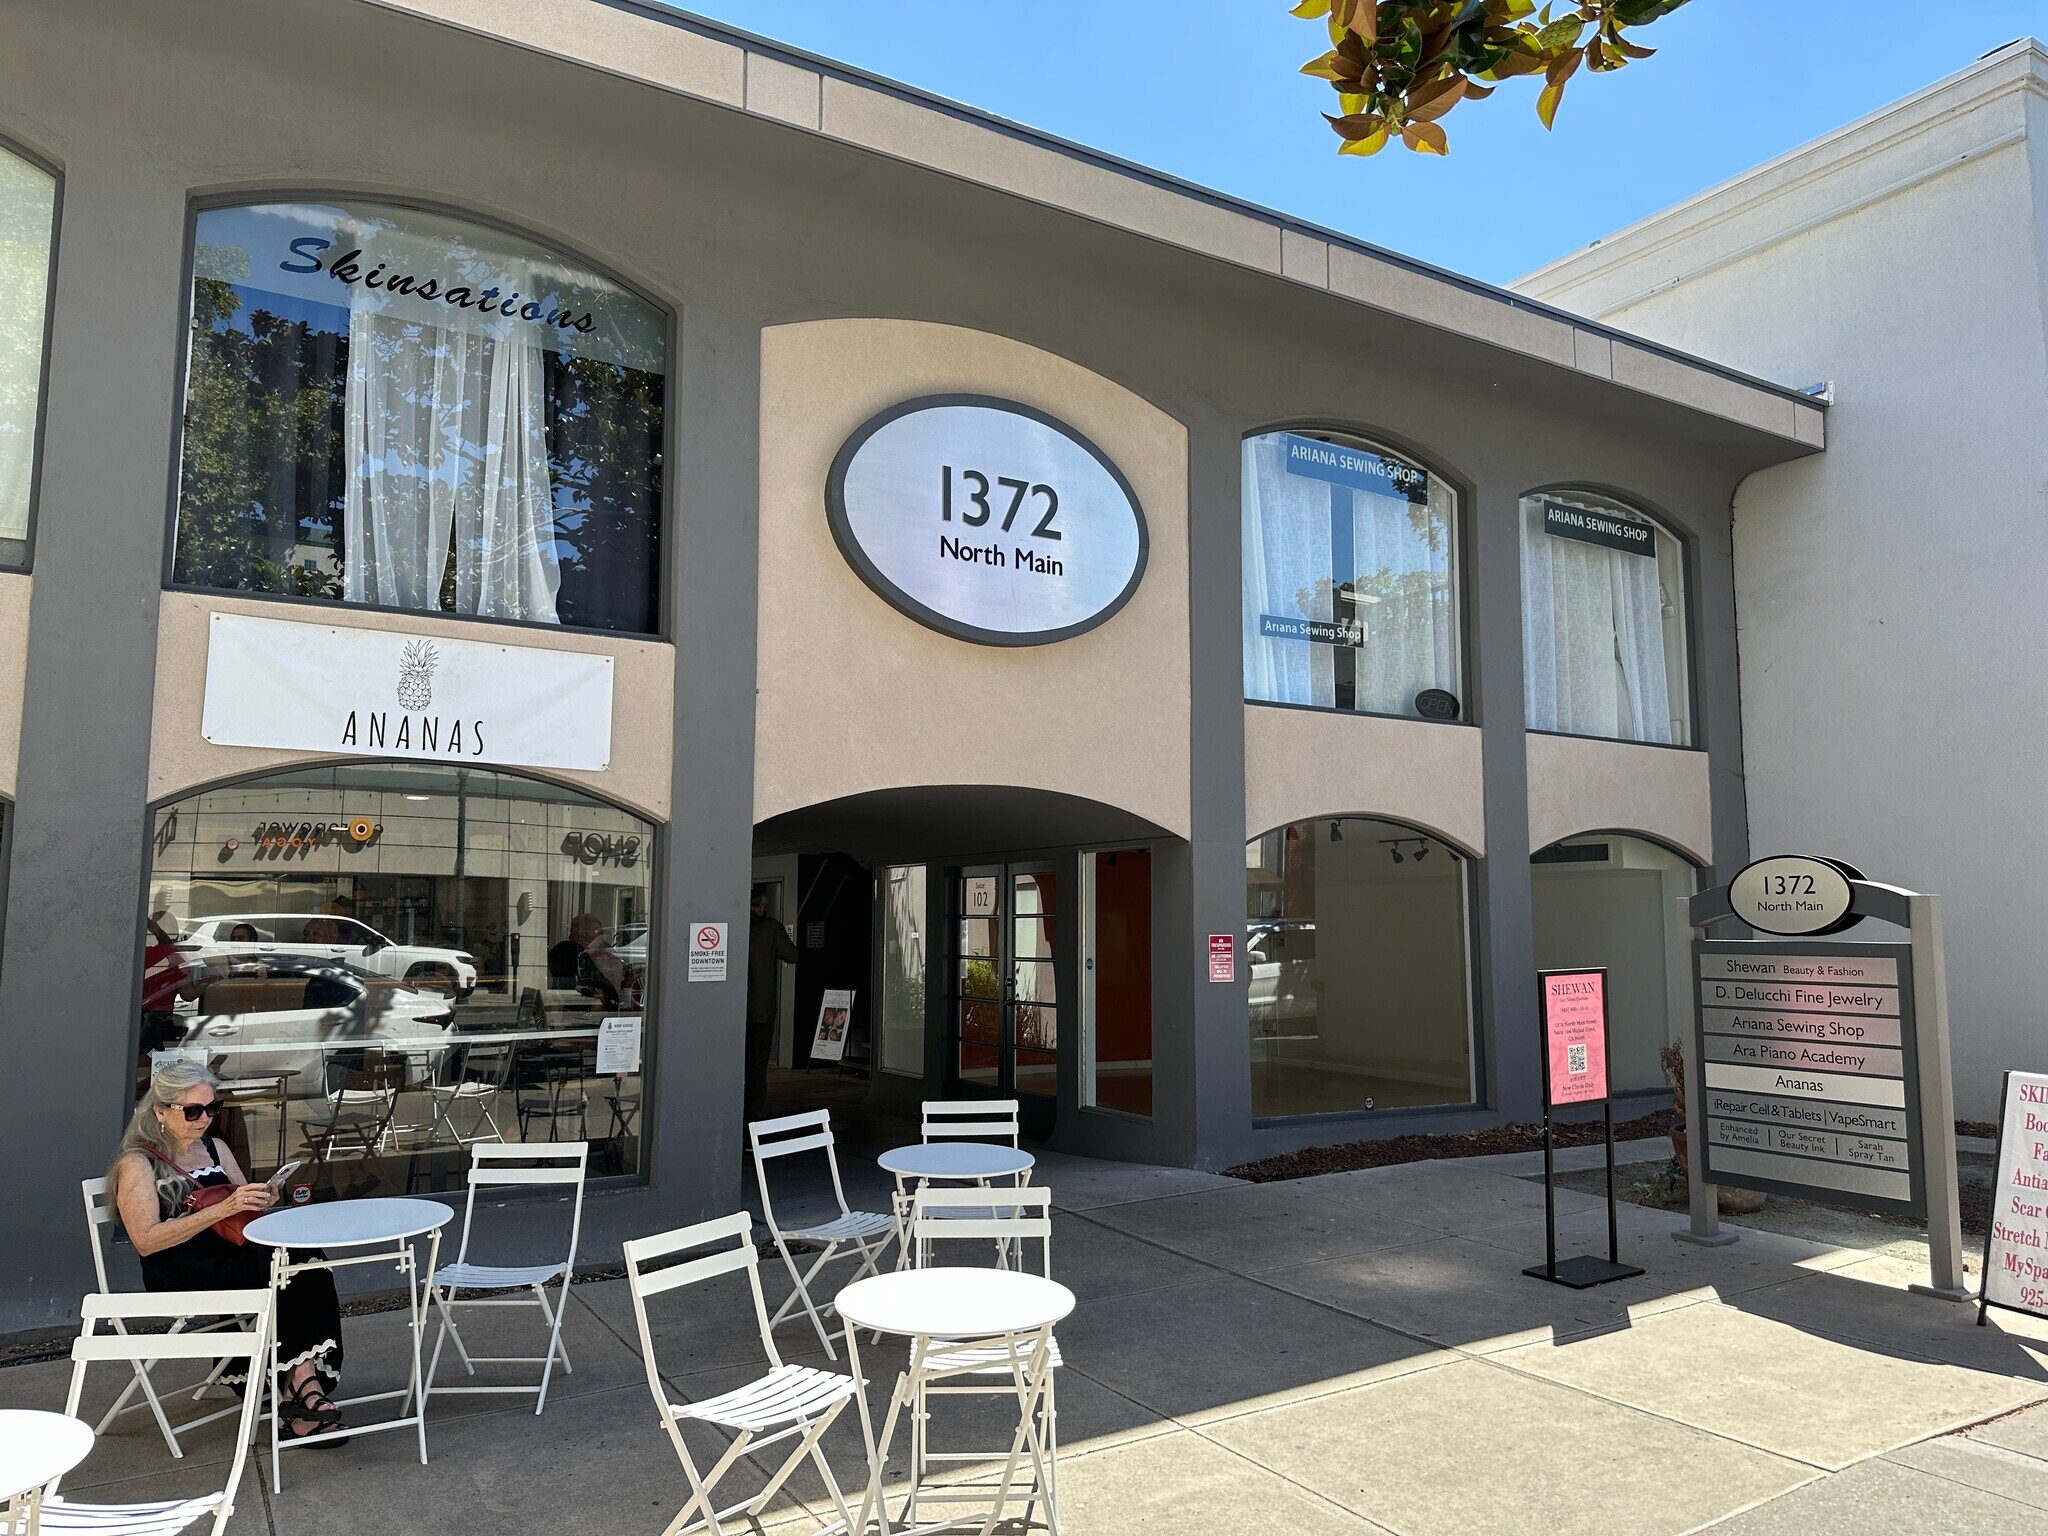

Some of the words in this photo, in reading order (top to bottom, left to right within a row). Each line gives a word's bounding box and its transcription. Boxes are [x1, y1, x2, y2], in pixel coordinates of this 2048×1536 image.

[280, 237, 597, 334] Skinsations
[1291, 445, 1337, 466] ARIANA
[1340, 455, 1385, 477] SEWING
[1387, 465, 1418, 482] SHOP
[942, 465, 1062, 540] 1372
[1548, 508, 1584, 528] ARIANA
[1586, 517, 1622, 537] SEWING
[1623, 527, 1648, 542] SHOP
[940, 535, 1005, 567] North
[1015, 547, 1063, 576] Main
[1265, 620, 1297, 634] Ariana
[1300, 623, 1335, 639] Sewing
[1337, 627, 1361, 642] Shop
[1420, 696, 1455, 714] OPEN
[342, 710, 484, 756] ANANAS
[1764, 875, 1816, 895] 1372
[973, 891, 988, 907] 102
[1757, 901, 1792, 911] North
[1796, 901, 1823, 911] Main
[1727, 960, 1776, 974] Shewan
[1783, 965, 1814, 977] Beauty
[1817, 966, 1825, 975] &
[1828, 966, 1864, 976] Fashion
[1551, 982, 1595, 996] SHEWAN
[1715, 986, 1730, 999] D.
[1735, 986, 1791, 1002] Delucchi
[1795, 990, 1824, 1003] Fine
[1828, 991, 1883, 1010] Jewelry
[1732, 1016, 1773, 1030] Ariana
[1777, 1018, 1825, 1038] Sewing
[1829, 1022, 1865, 1040] Shop
[1733, 1044, 1756, 1057] Ara
[1760, 1045, 1796, 1060] Piano
[1800, 1049, 1866, 1069] Academy
[1775, 1075, 1823, 1091] Ananas
[1714, 1099, 1747, 1114] iRepair
[1828, 1111, 1897, 1130] VapeSmart
[1720, 1123, 1758, 1135] Enhanced
[1720, 1133, 1729, 1141] by
[1732, 1133, 1759, 1144] Amelia
[1778, 1130, 1795, 1139] Our
[1798, 1132, 1826, 1143] Secret
[1780, 1139, 1808, 1152] Beauty
[1812, 1144, 1825, 1153] Ink
[1848, 1149, 1874, 1161] Spray
[1876, 1152, 1895, 1162] Tan
[1858, 1140, 1884, 1151] Sarah
[2011, 1196, 2042, 1218] Scar
[1993, 1221, 2041, 1247] Stretch
